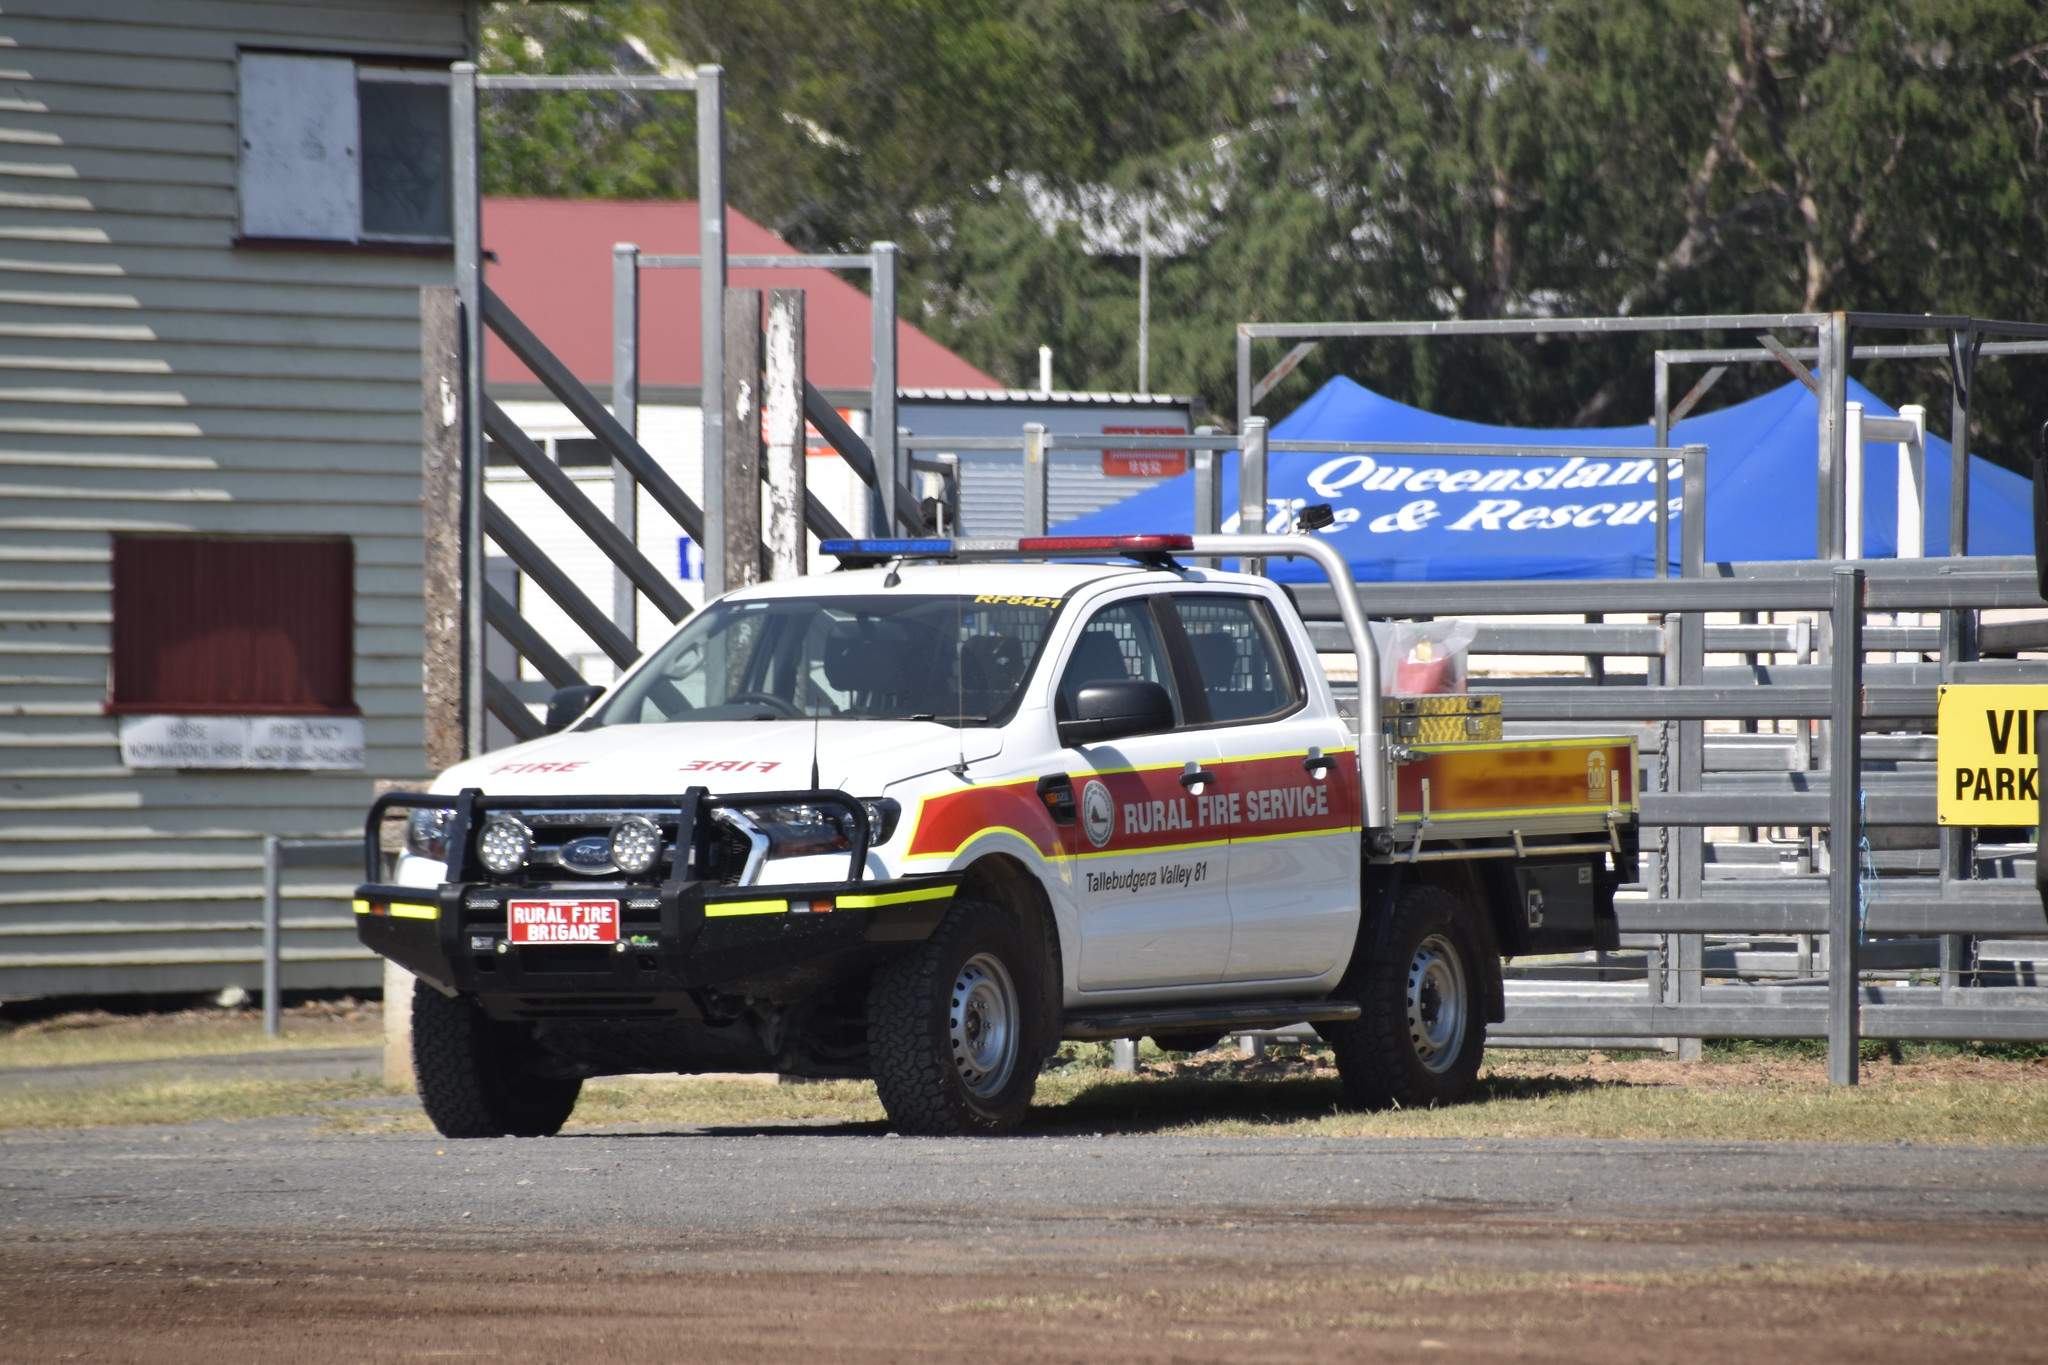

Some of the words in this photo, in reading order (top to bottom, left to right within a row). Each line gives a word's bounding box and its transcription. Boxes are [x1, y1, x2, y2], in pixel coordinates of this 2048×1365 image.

[1369, 499, 1443, 533] &
[1446, 497, 1683, 532] Rescue
[974, 594, 1062, 609] RF8421
[490, 761, 591, 775] FIRE
[1587, 767, 1606, 788] 000
[1124, 798, 1193, 835] RURAL
[1198, 793, 1242, 826] FIRE
[1247, 784, 1329, 822] SERVICE
[1086, 868, 1157, 893] Tallebudgera
[1160, 863, 1193, 888] Valley
[1194, 861, 1208, 882] 81
[514, 907, 567, 924] RURAL
[572, 906, 612, 923] FIRE
[528, 924, 601, 941] BRIGADE
